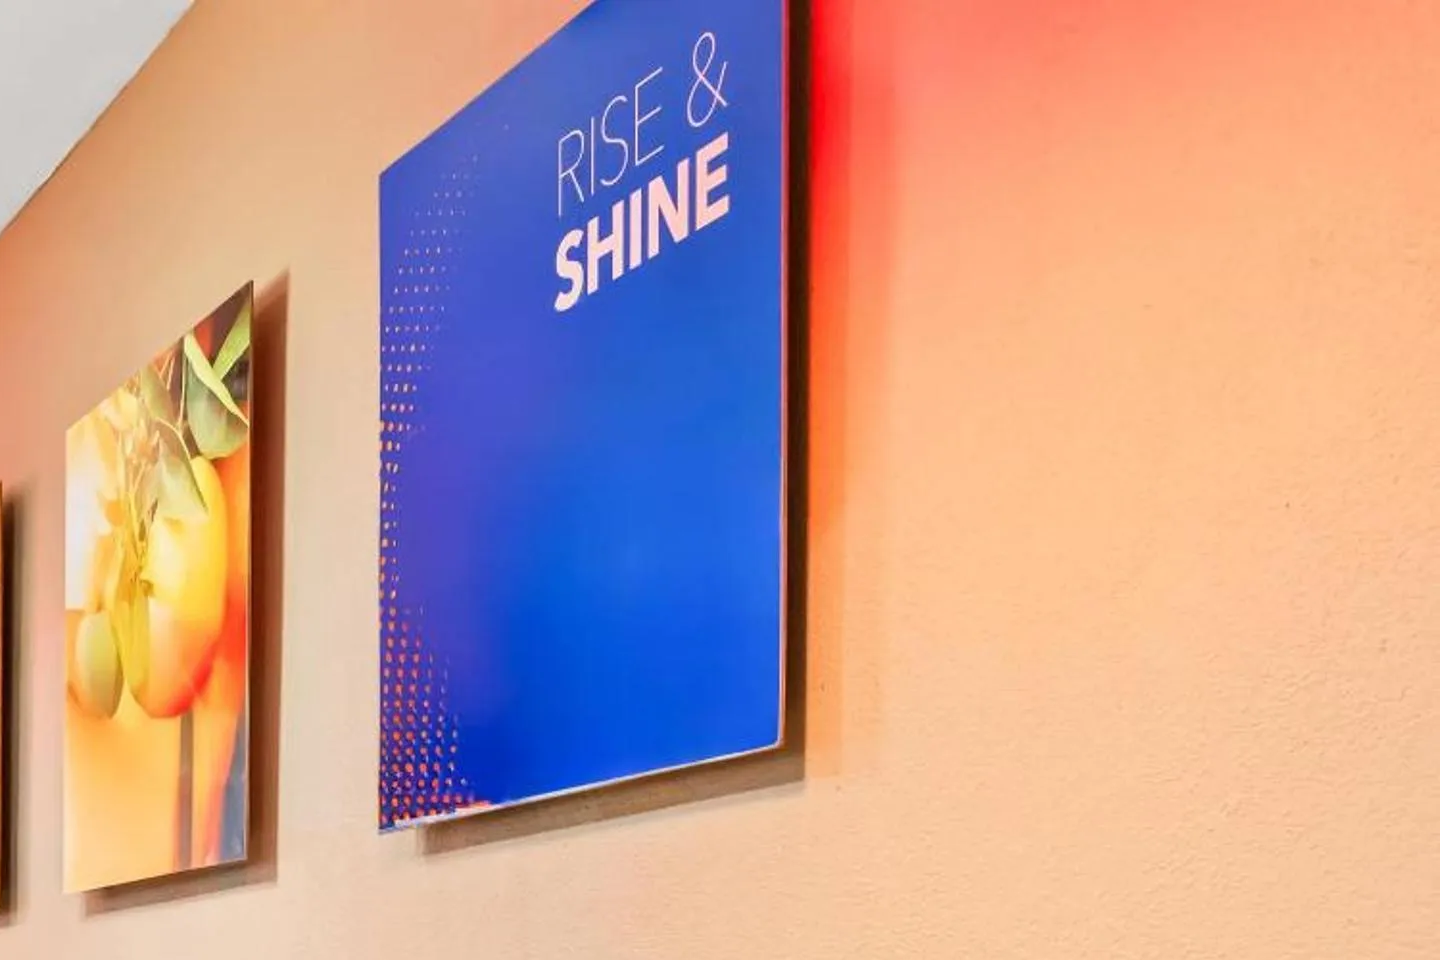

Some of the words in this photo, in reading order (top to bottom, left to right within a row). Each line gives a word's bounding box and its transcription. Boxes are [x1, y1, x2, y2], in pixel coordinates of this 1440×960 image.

[558, 66, 664, 217] RISE
[686, 31, 728, 128] &
[554, 131, 730, 312] SHINE
